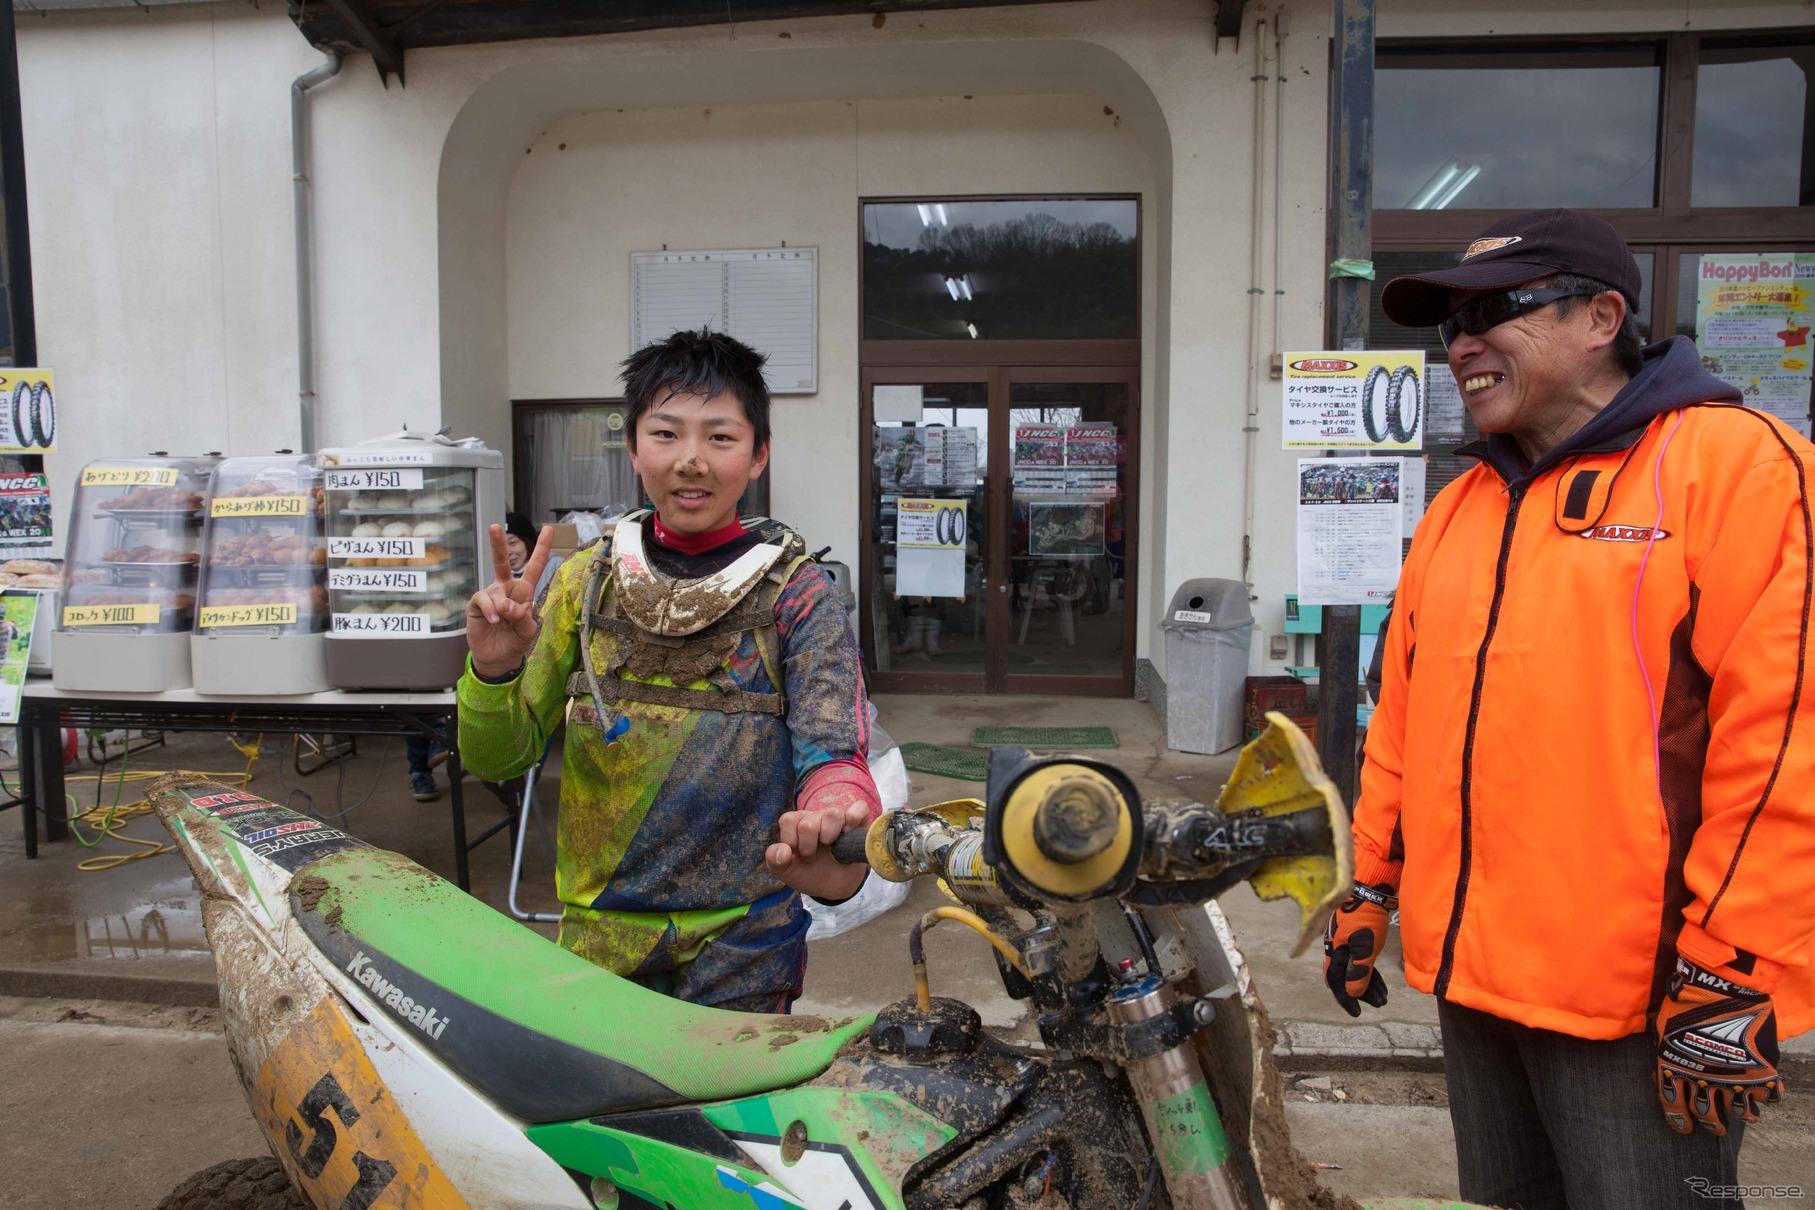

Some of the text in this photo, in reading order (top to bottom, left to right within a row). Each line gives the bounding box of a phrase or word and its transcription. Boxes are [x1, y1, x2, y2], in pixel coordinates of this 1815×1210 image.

[1300, 360, 1347, 371] MAXXIS
[1288, 385, 1358, 393] タイヤ交換サービス
[1023, 429, 1058, 437] JNCC
[1074, 429, 1110, 437] JNCC
[84, 472, 129, 482] あげどり
[328, 471, 400, 488] 肉まん ¥150
[214, 499, 300, 513] からあげ棒 ¥150
[331, 540, 413, 555] ピザまん ¥150
[331, 573, 417, 587] デミグラまん ¥150
[67, 607, 135, 622] コロッケ ¥100
[255, 606, 290, 621] ¥150
[334, 616, 421, 632] 豚まん ¥200
[245, 821, 321, 843] AMSOIL
[1697, 972, 1733, 991] MX
[345, 950, 450, 1041] Kawasaki
